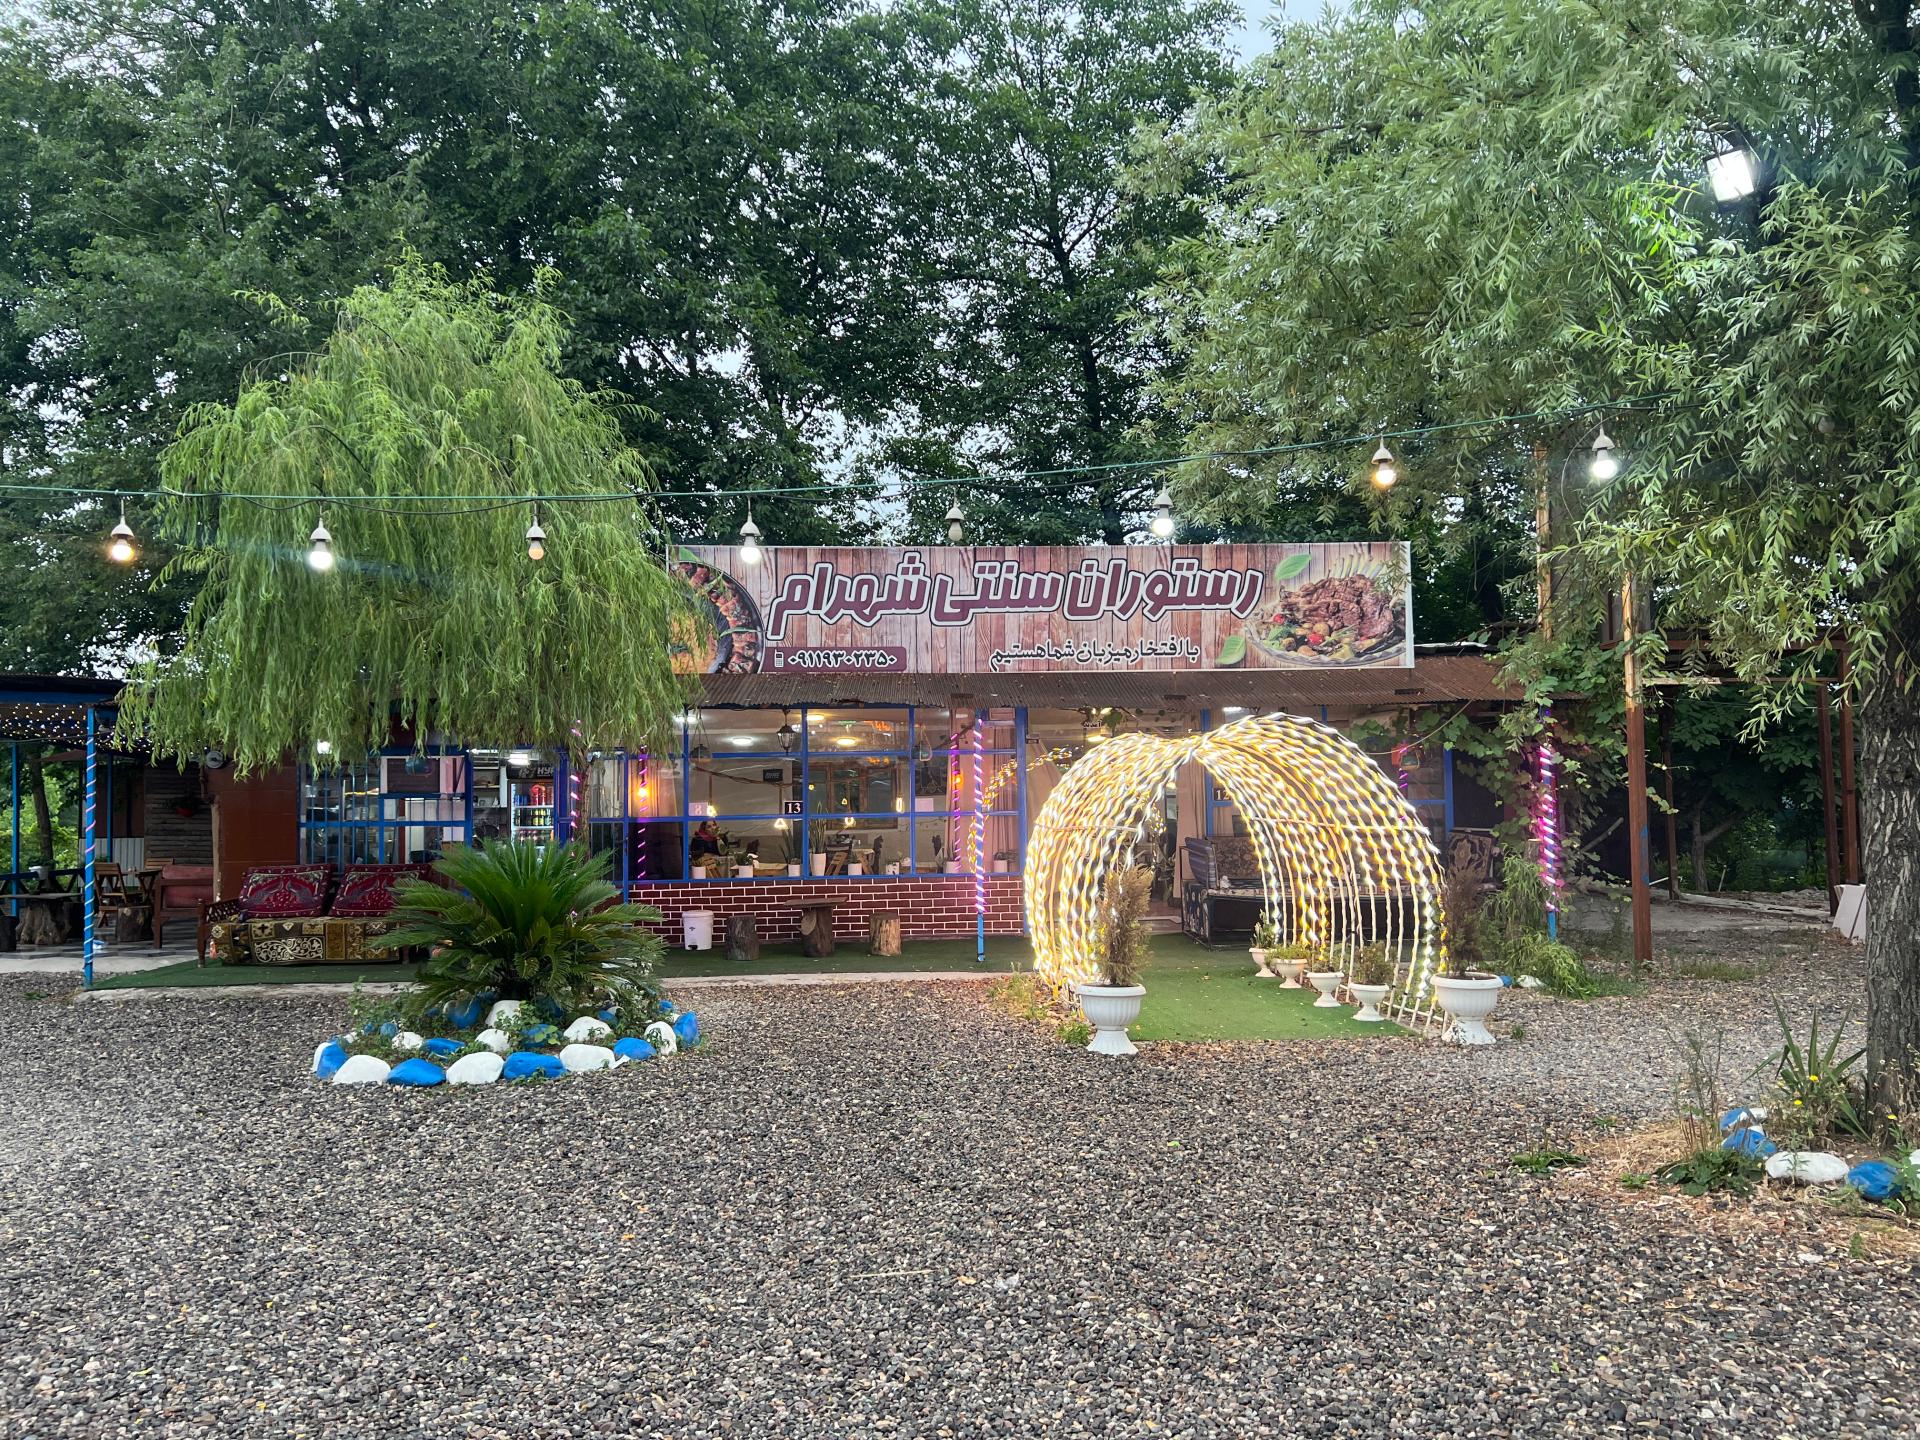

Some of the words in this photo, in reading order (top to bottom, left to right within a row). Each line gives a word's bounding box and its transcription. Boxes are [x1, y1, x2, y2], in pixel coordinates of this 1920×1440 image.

[766, 551, 931, 641] شهرام
[931, 560, 1064, 626] سنتی
[1062, 558, 1263, 621] رستوران
[989, 643, 1047, 672] هستیم
[1046, 639, 1074, 661] شما
[1076, 639, 1132, 665] میزبان
[1130, 636, 1184, 664] افتخار
[787, 803, 801, 814] 13
[1216, 789, 1230, 800] 12
